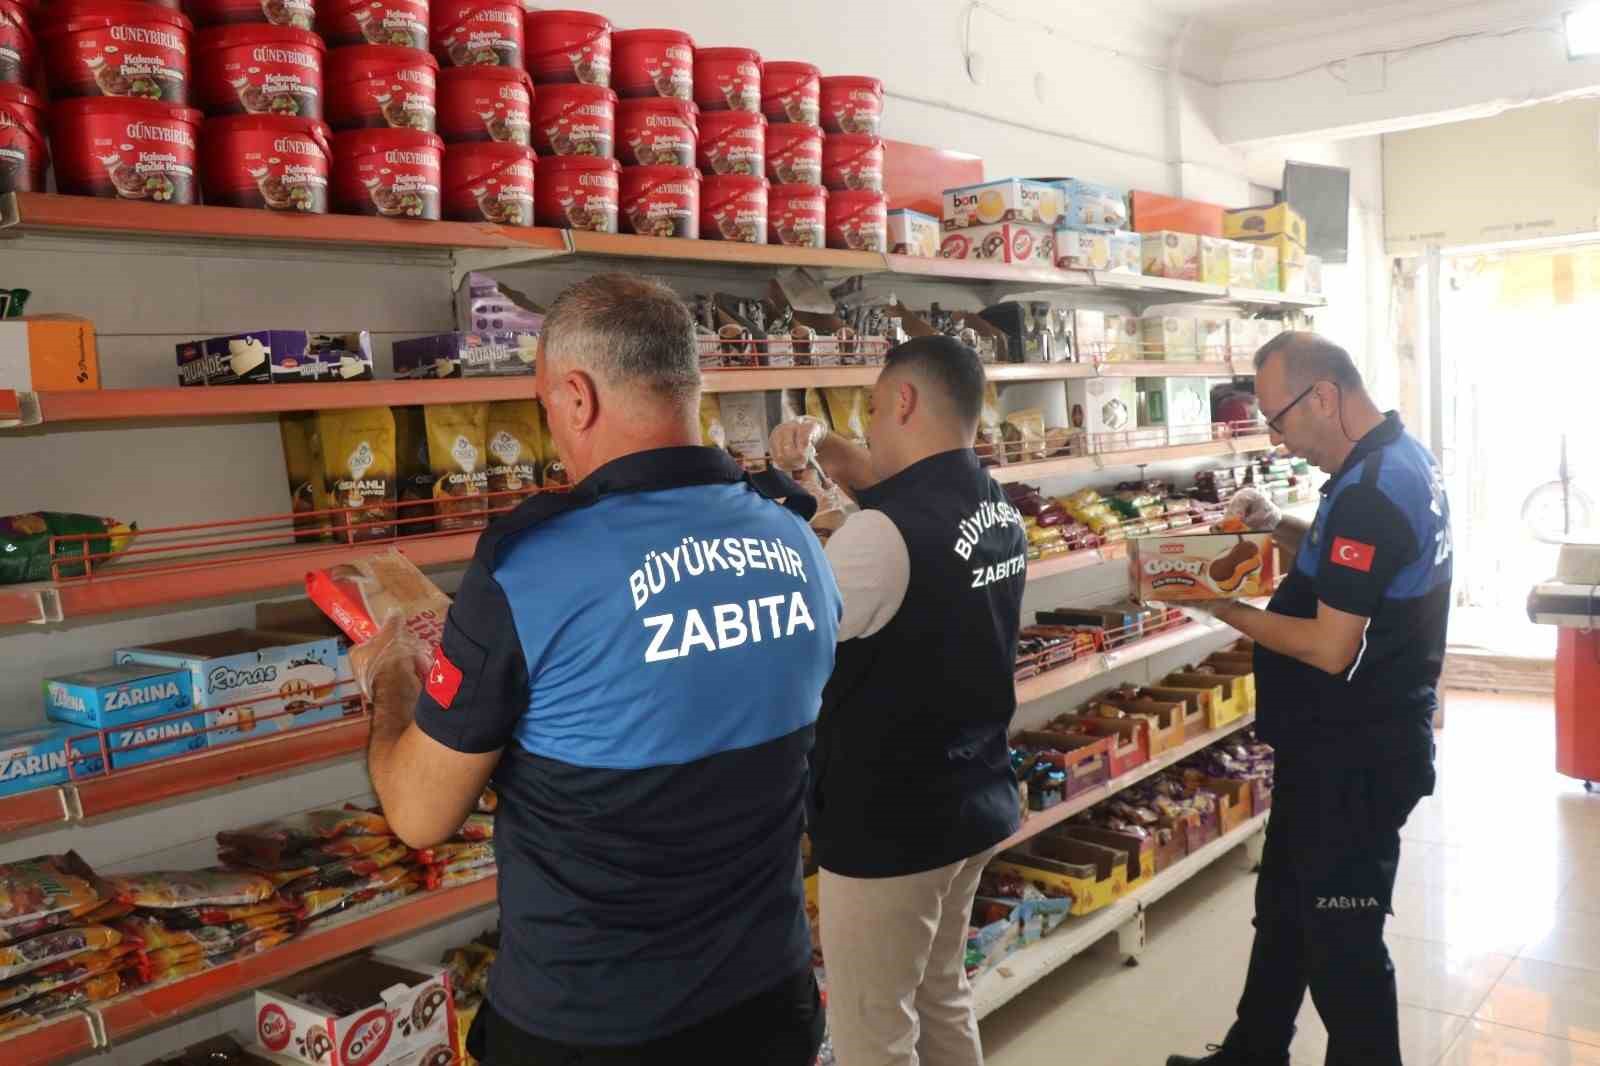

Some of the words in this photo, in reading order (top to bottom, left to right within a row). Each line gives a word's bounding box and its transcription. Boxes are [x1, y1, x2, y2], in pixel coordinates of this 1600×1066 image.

[953, 500, 1023, 561] BÜYÜKŞEH
[629, 536, 808, 611] BÜYÜKŞEHİR
[971, 554, 1025, 588] ZABITA
[643, 591, 816, 663] ZABITA
[104, 681, 180, 713] ZARINA
[208, 665, 278, 695] Ronas
[1316, 895, 1378, 909] ZABITA
[350, 1020, 384, 1056] ONE
